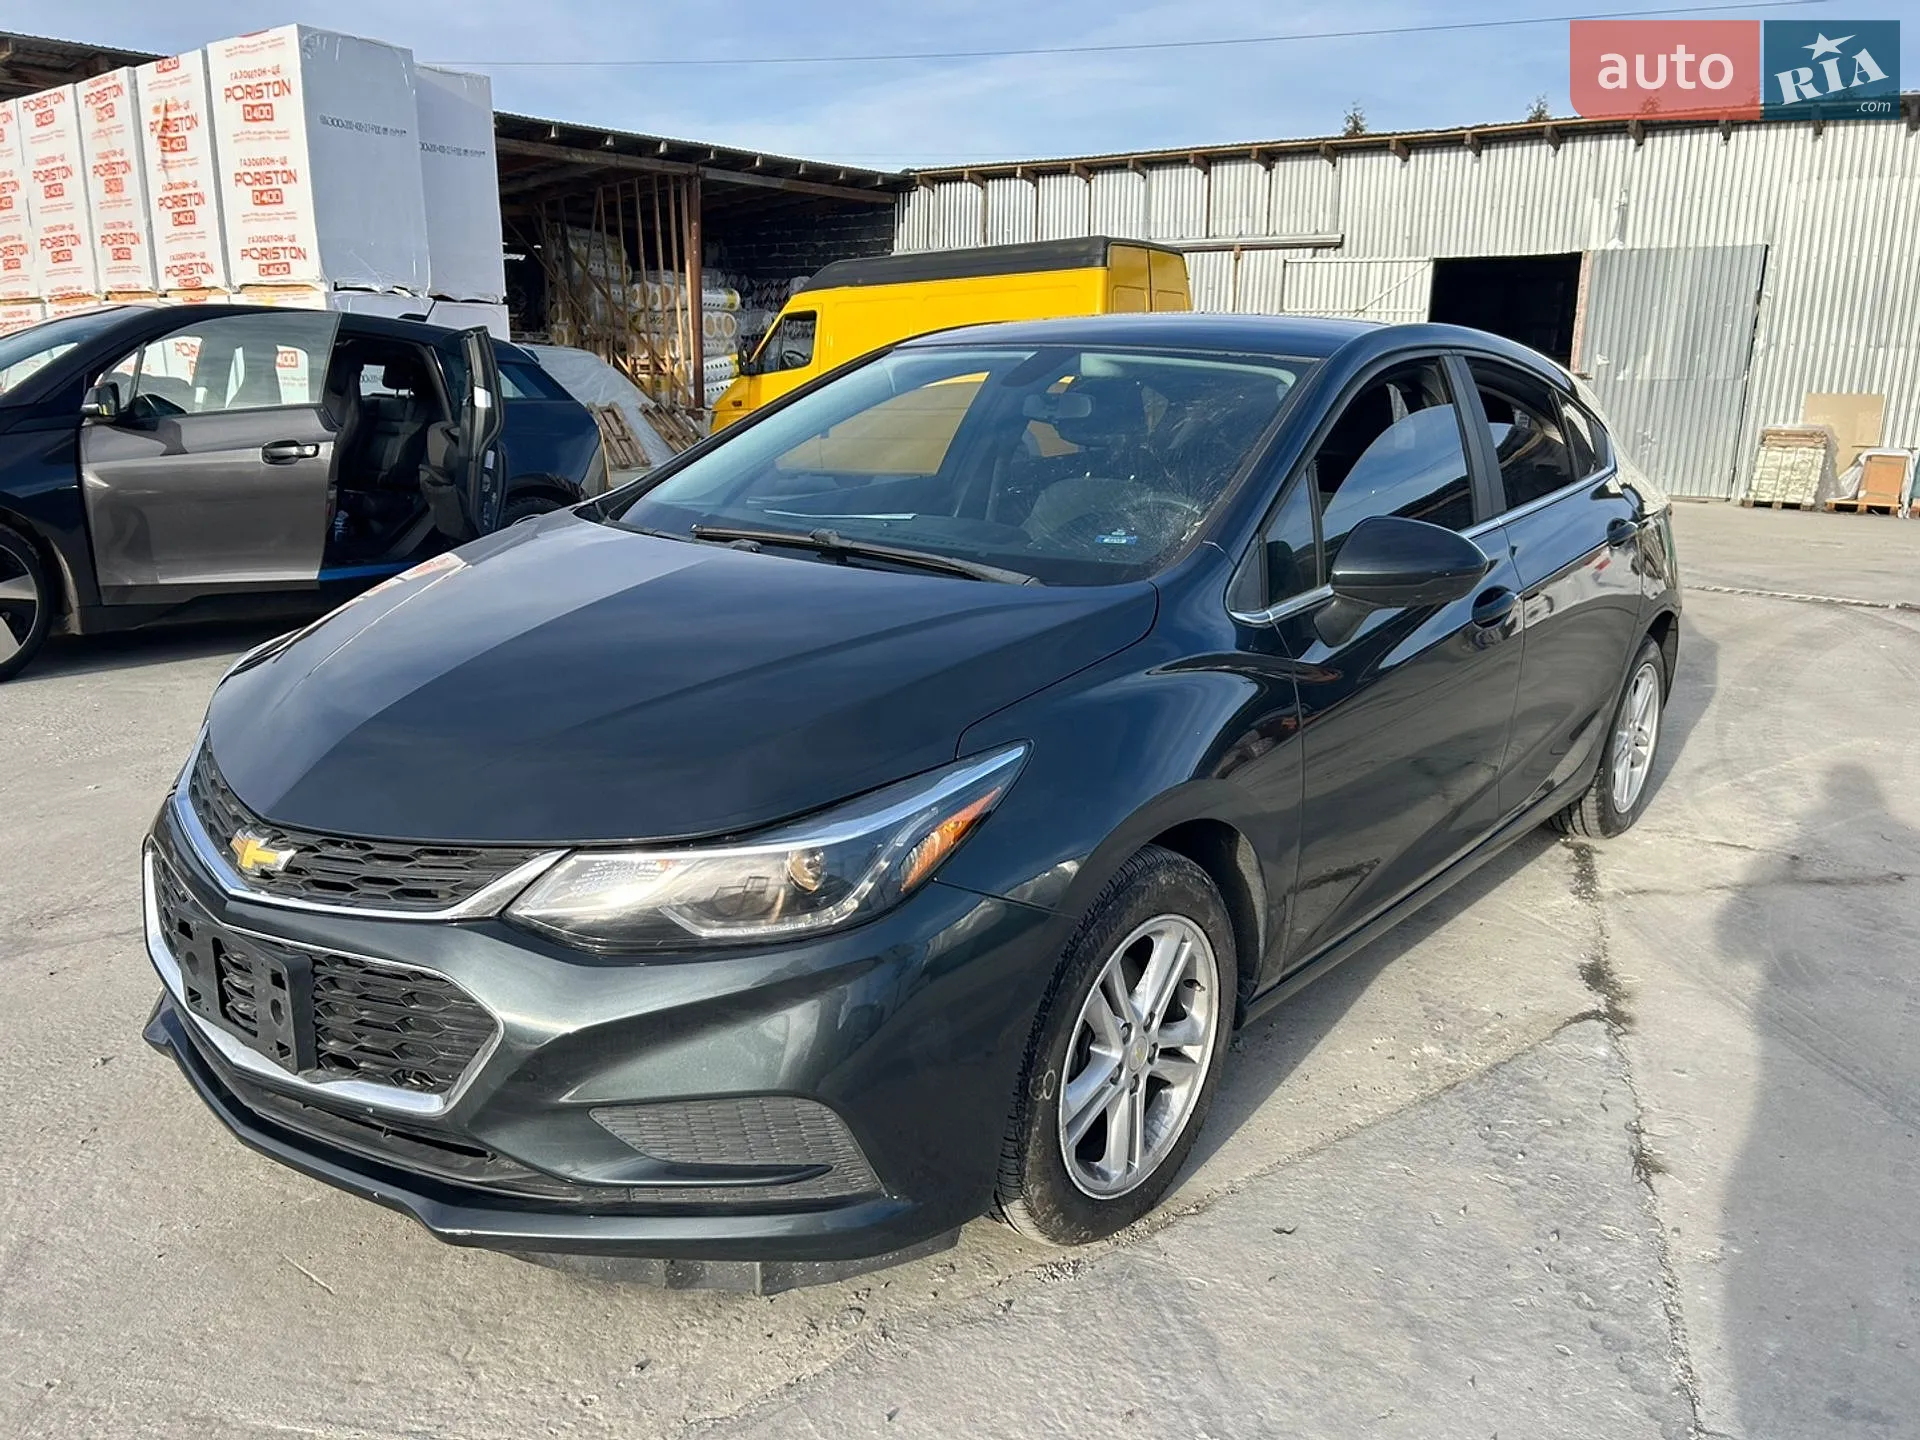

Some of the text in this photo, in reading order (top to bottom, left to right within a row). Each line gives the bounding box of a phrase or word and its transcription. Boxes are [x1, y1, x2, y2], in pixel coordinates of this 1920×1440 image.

[224, 79, 292, 103] PORISTON
[234, 168, 298, 188] PORISTON
[158, 191, 206, 211] PORISTON
[253, 189, 282, 205] D400
[241, 246, 307, 261] PORISTON
